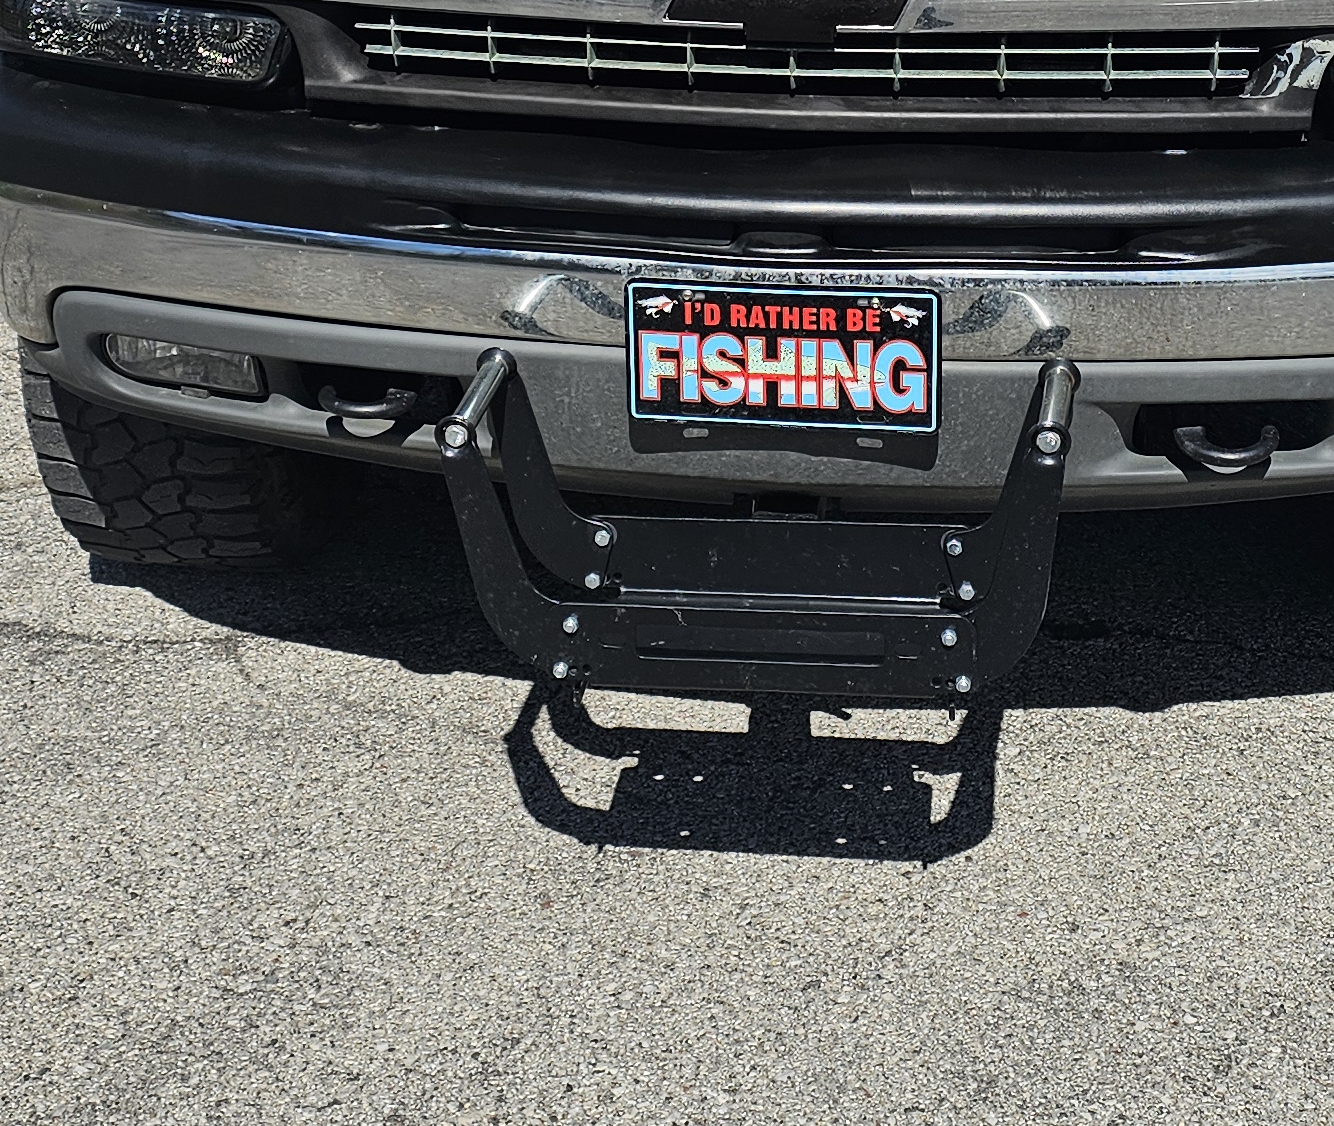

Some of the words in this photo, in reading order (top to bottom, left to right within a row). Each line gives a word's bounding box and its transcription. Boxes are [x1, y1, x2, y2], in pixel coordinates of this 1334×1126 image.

[684, 302, 721, 326] I'D
[730, 304, 837, 330] RATHER
[846, 308, 881, 332] BE
[638, 330, 928, 414] FISHING
